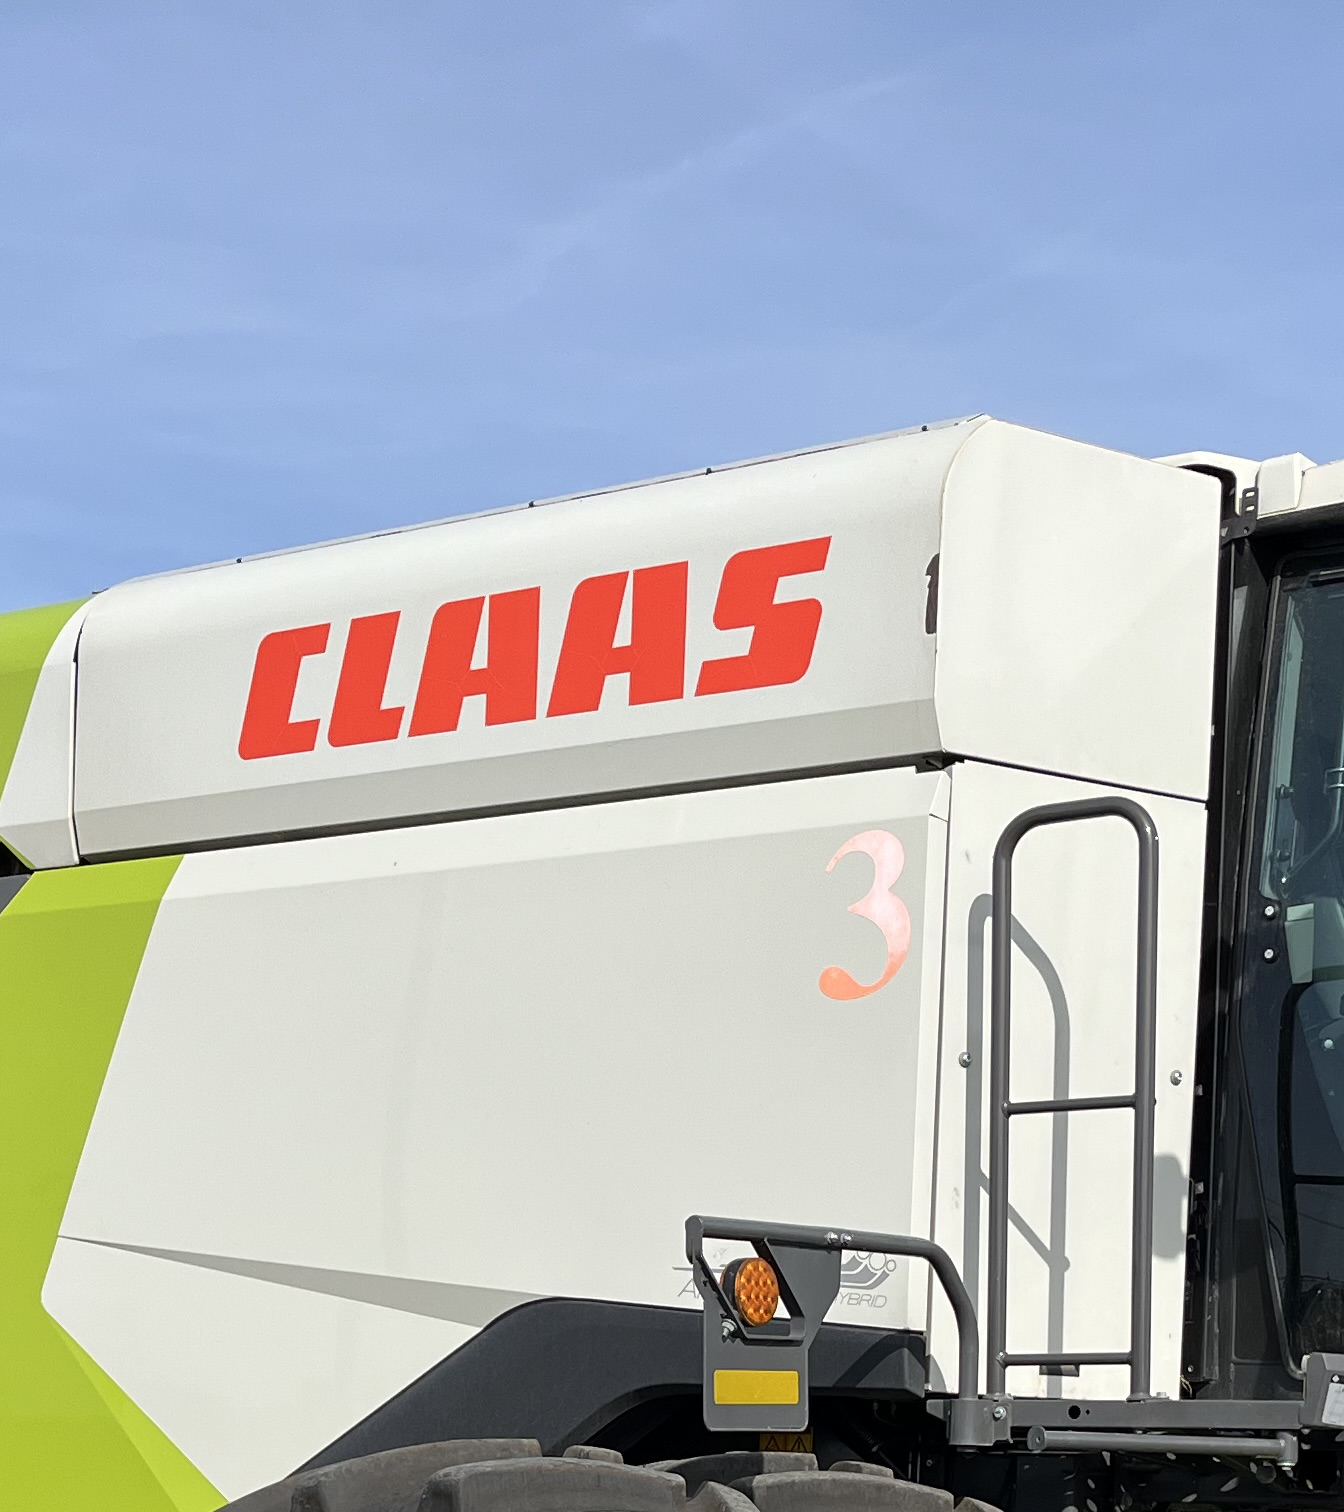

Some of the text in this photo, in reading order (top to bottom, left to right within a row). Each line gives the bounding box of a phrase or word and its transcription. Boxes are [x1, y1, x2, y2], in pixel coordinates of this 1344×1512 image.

[237, 536, 832, 761] CLAAS
[818, 829, 911, 1001] 3
[833, 1291, 888, 1309] YBRID
